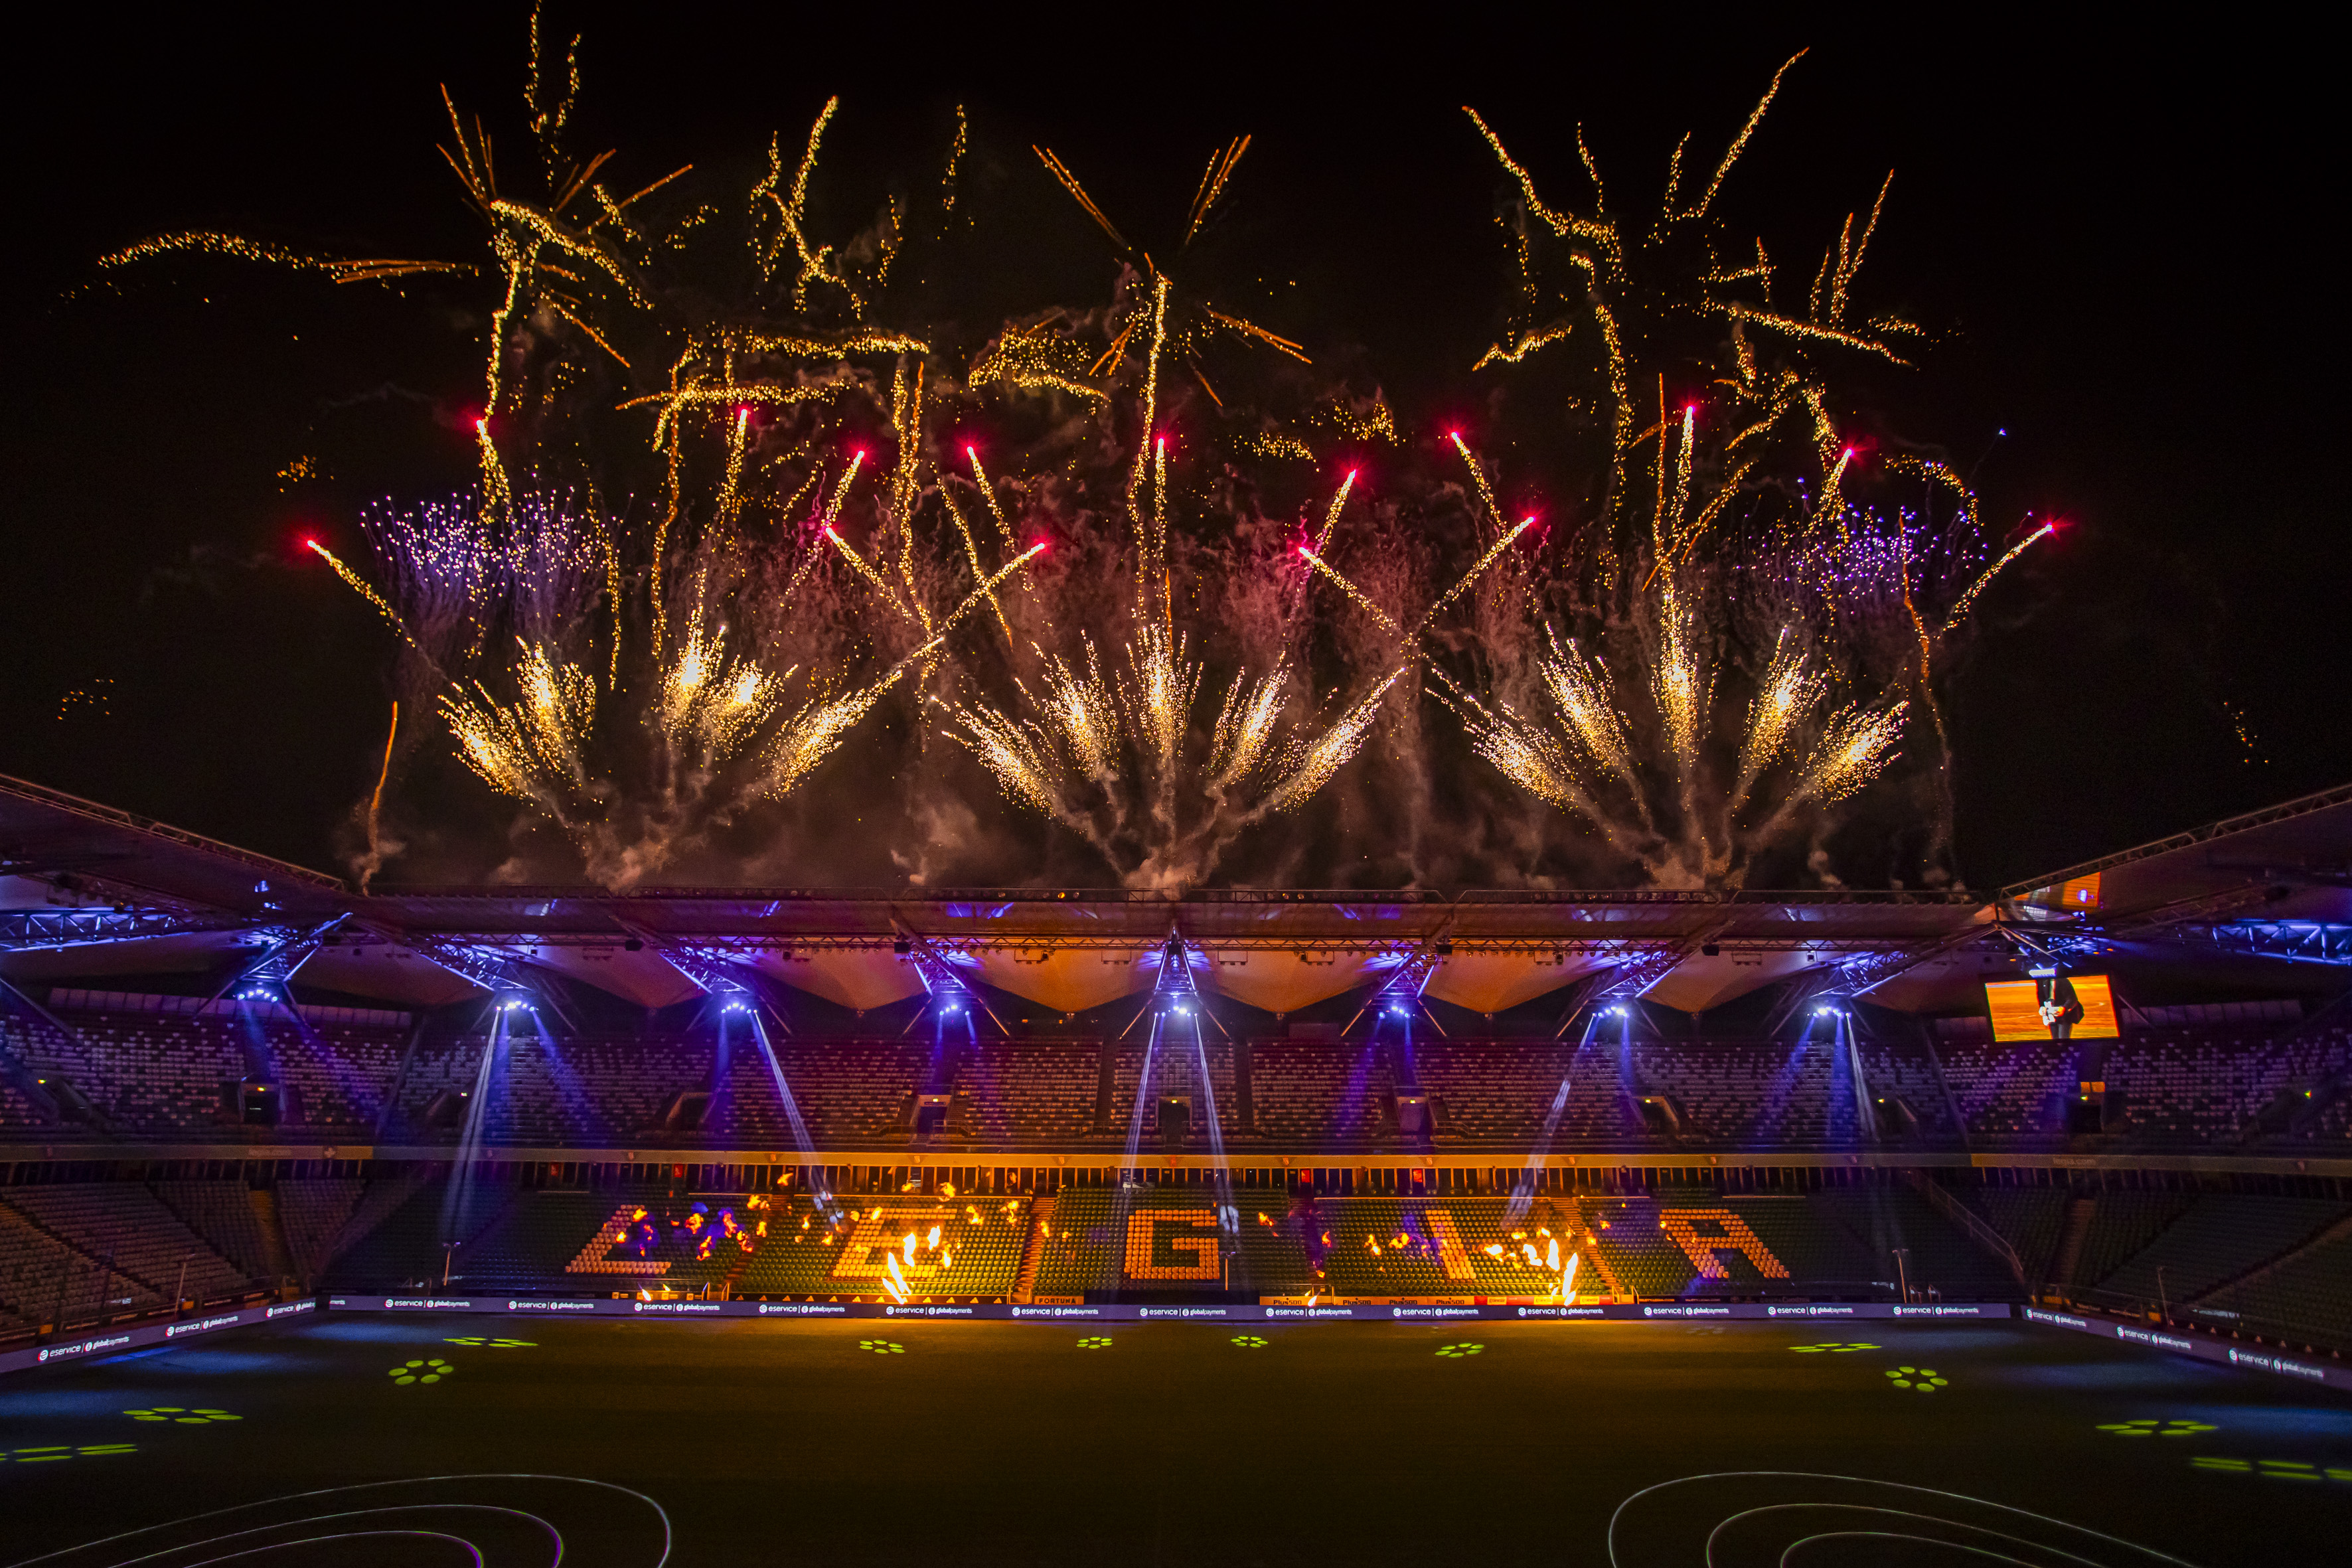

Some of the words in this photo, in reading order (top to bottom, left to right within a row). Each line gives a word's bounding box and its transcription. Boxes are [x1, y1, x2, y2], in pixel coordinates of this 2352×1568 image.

[684, 1303, 721, 1312] globalpayments
[935, 1306, 973, 1315] globalpayments
[1316, 1308, 1352, 1316] globalpayments
[2033, 1312, 2053, 1320] eservice
[175, 1322, 200, 1333] eservice
[2124, 1330, 2149, 1340] eservice
[49, 1345, 81, 1357] eservice
[2238, 1354, 2270, 1366] eservice
